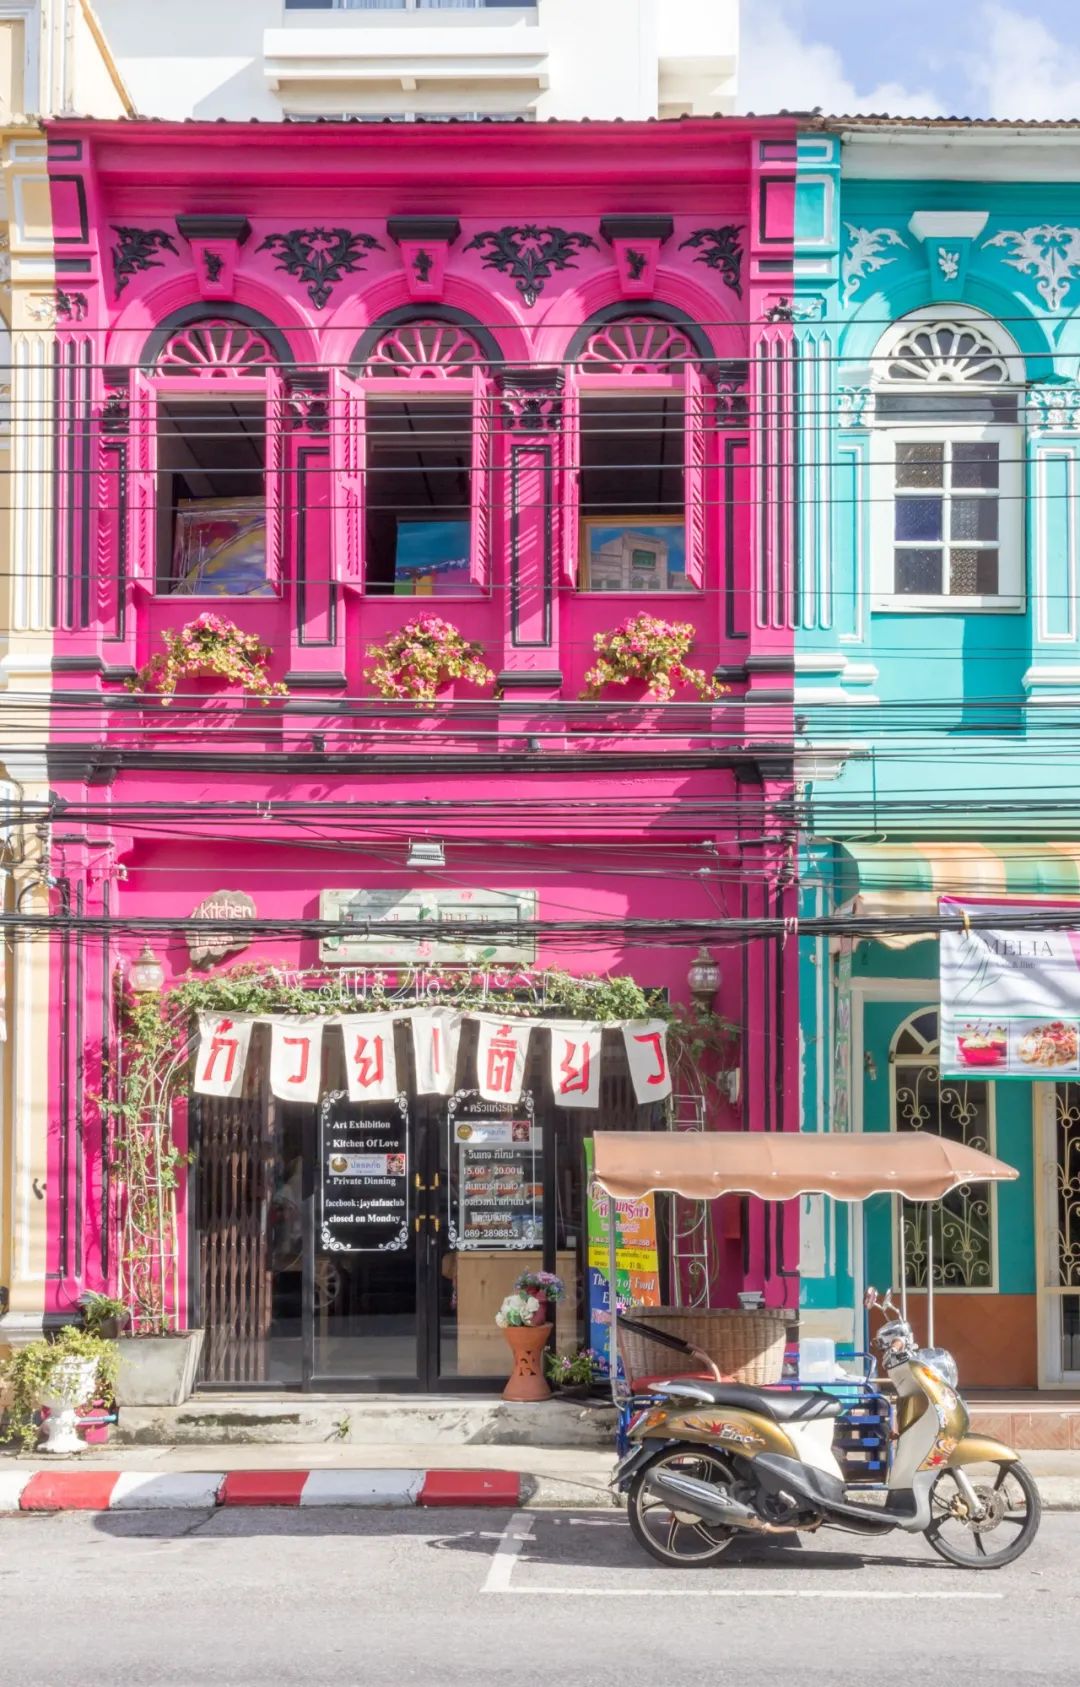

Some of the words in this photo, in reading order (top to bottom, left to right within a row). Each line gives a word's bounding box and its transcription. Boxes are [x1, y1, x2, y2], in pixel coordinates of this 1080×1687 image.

[201, 899, 252, 921] Kitchen
[332, 1120, 348, 1129] Art
[349, 1120, 391, 1129] Exhibition
[332, 1139, 364, 1148] Kitchen
[366, 1139, 377, 1148] Of
[379, 1139, 399, 1148] Love
[333, 1177, 362, 1186] Private
[364, 1177, 396, 1187] Dinning
[329, 1214, 353, 1222] closed
[368, 1214, 400, 1224] Monday
[593, 1274, 607, 1286] The
